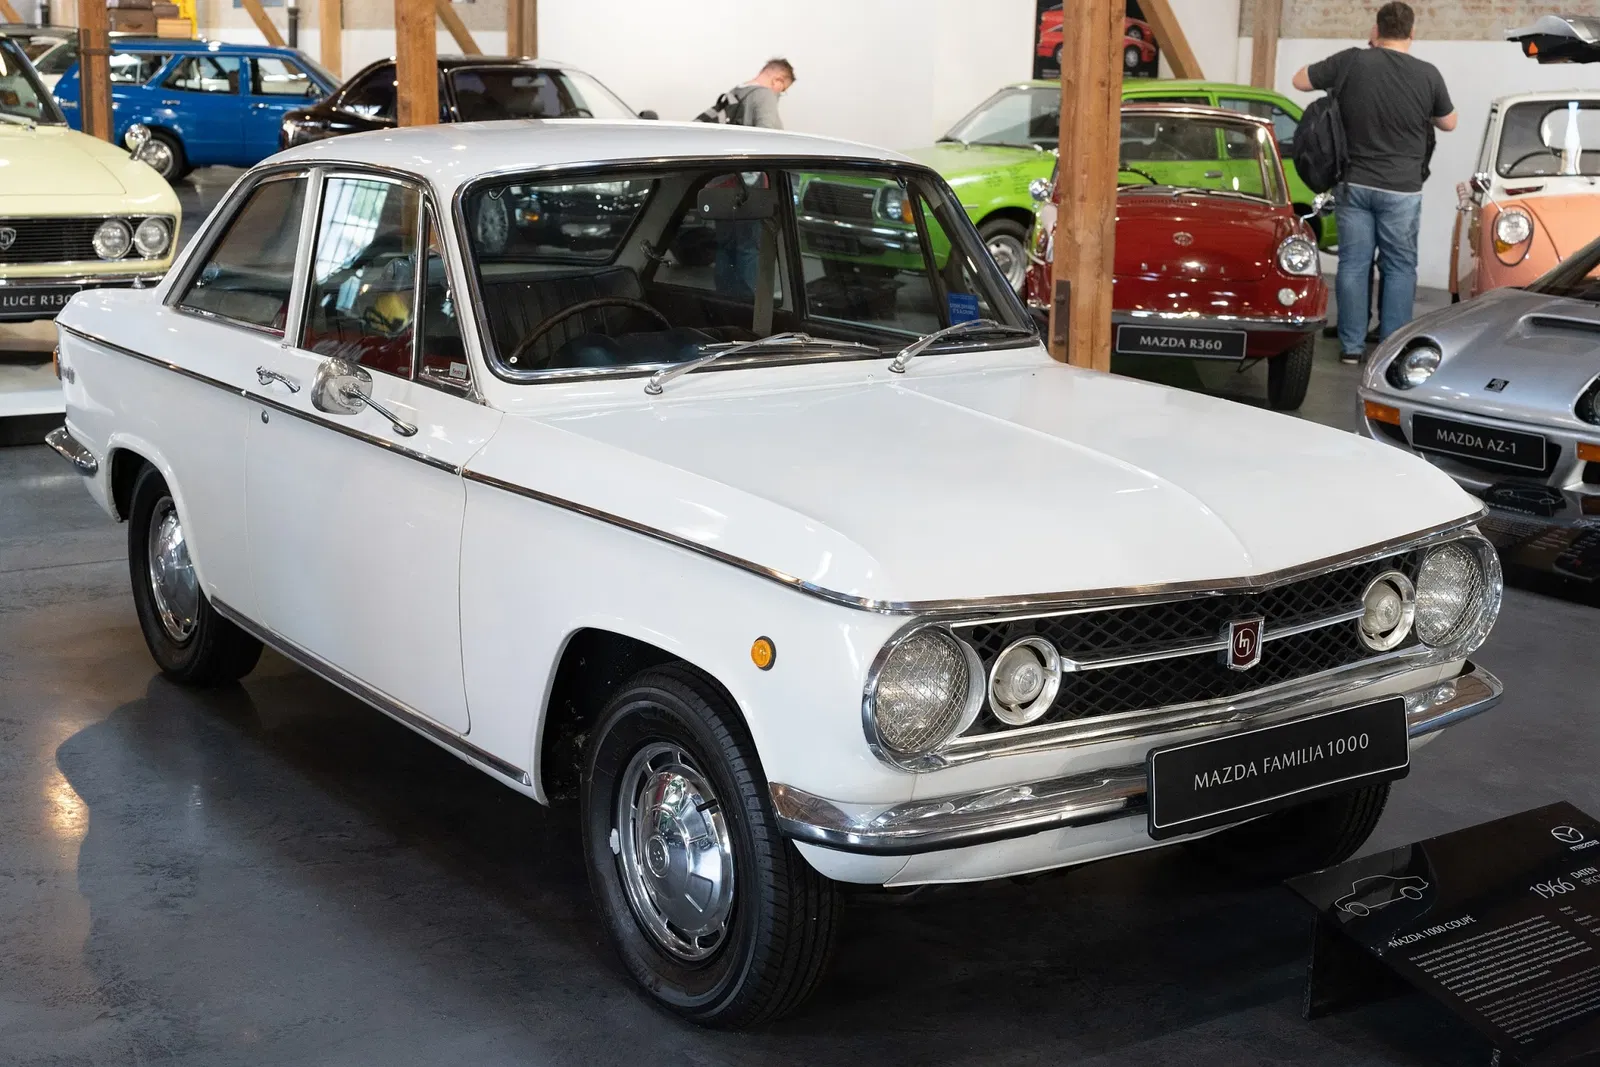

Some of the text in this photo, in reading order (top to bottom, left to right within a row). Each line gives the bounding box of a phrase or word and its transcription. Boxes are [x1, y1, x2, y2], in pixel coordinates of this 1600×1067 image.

[3, 295, 37, 307] LUCE
[1140, 336, 1223, 351] MAZDA R360
[1436, 429, 1517, 455] MAZDA AZ-1
[1194, 733, 1370, 791] MAZDA FAMILIA 1000
[1570, 866, 1599, 879] DATEN
[1529, 877, 1576, 899] 1966
[1388, 932, 1426, 948] MAZDA
[1423, 924, 1447, 937] 1000
